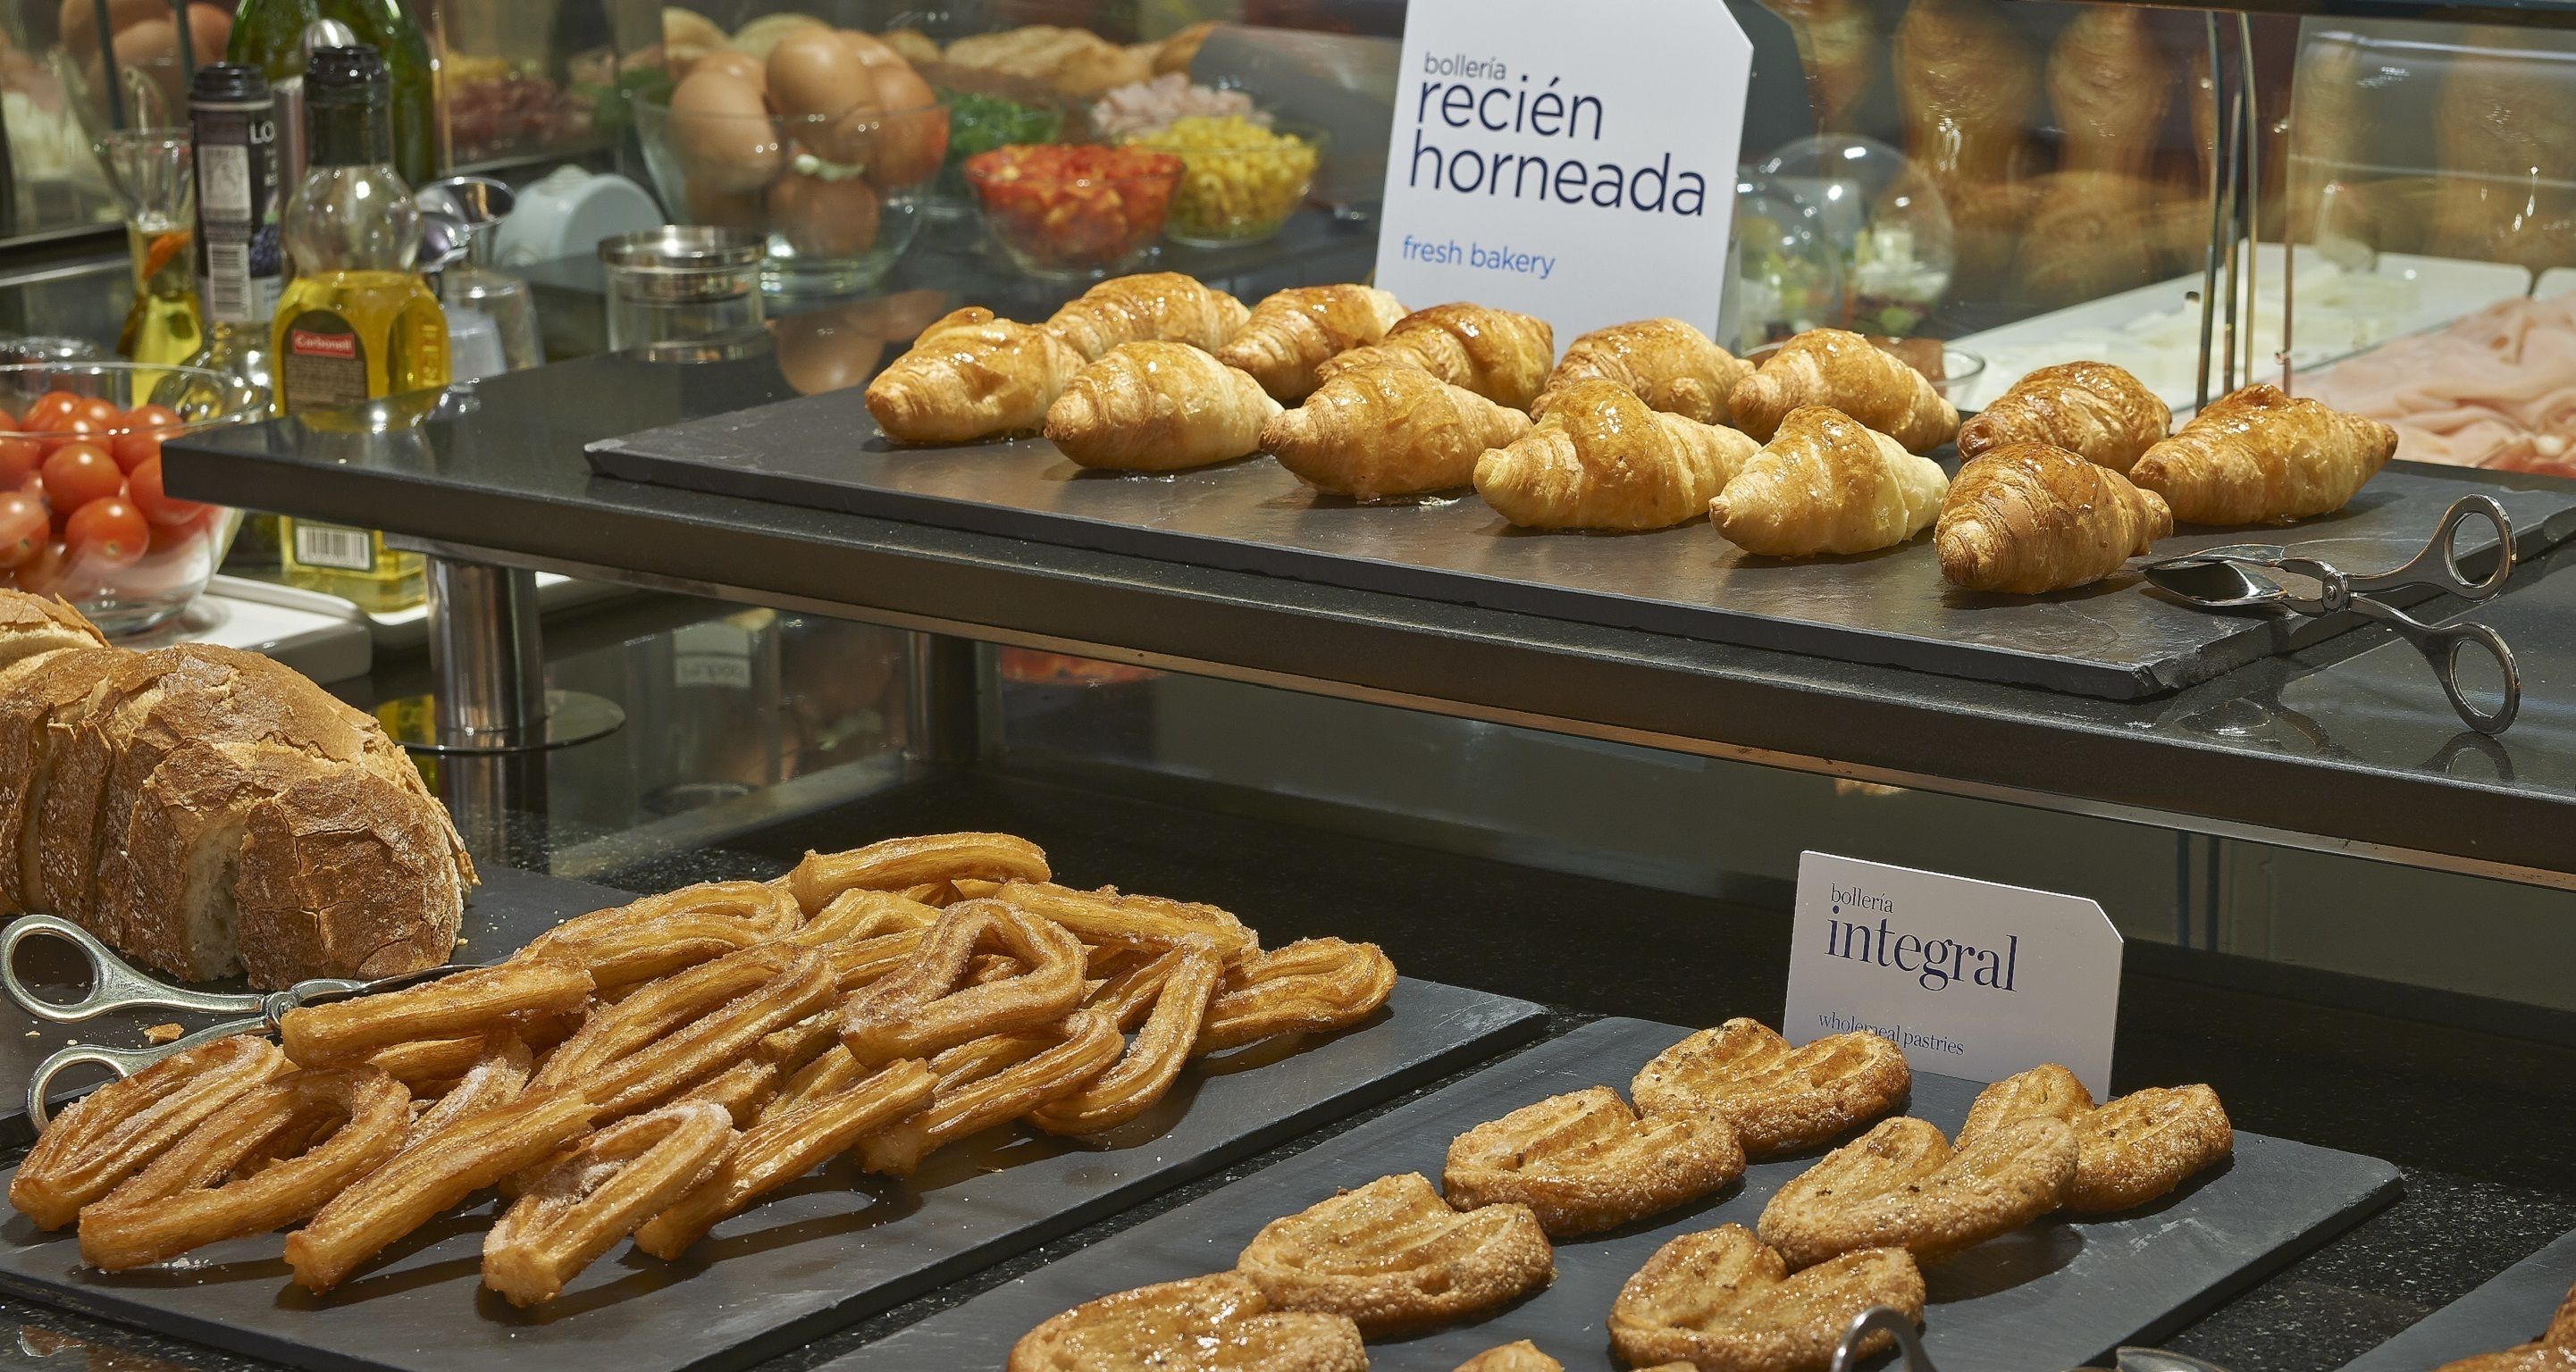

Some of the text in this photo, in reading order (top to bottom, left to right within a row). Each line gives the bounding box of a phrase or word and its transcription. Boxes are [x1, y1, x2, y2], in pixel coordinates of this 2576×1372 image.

[1423, 51, 1506, 79] bollería
[1417, 74, 1603, 140] recién
[1410, 129, 1706, 216] horneada
[1403, 234, 1556, 280] fresh bakery
[1830, 883, 1894, 914] bollería
[1824, 905, 2018, 992] integral
[1903, 1031, 1965, 1056] pastries
